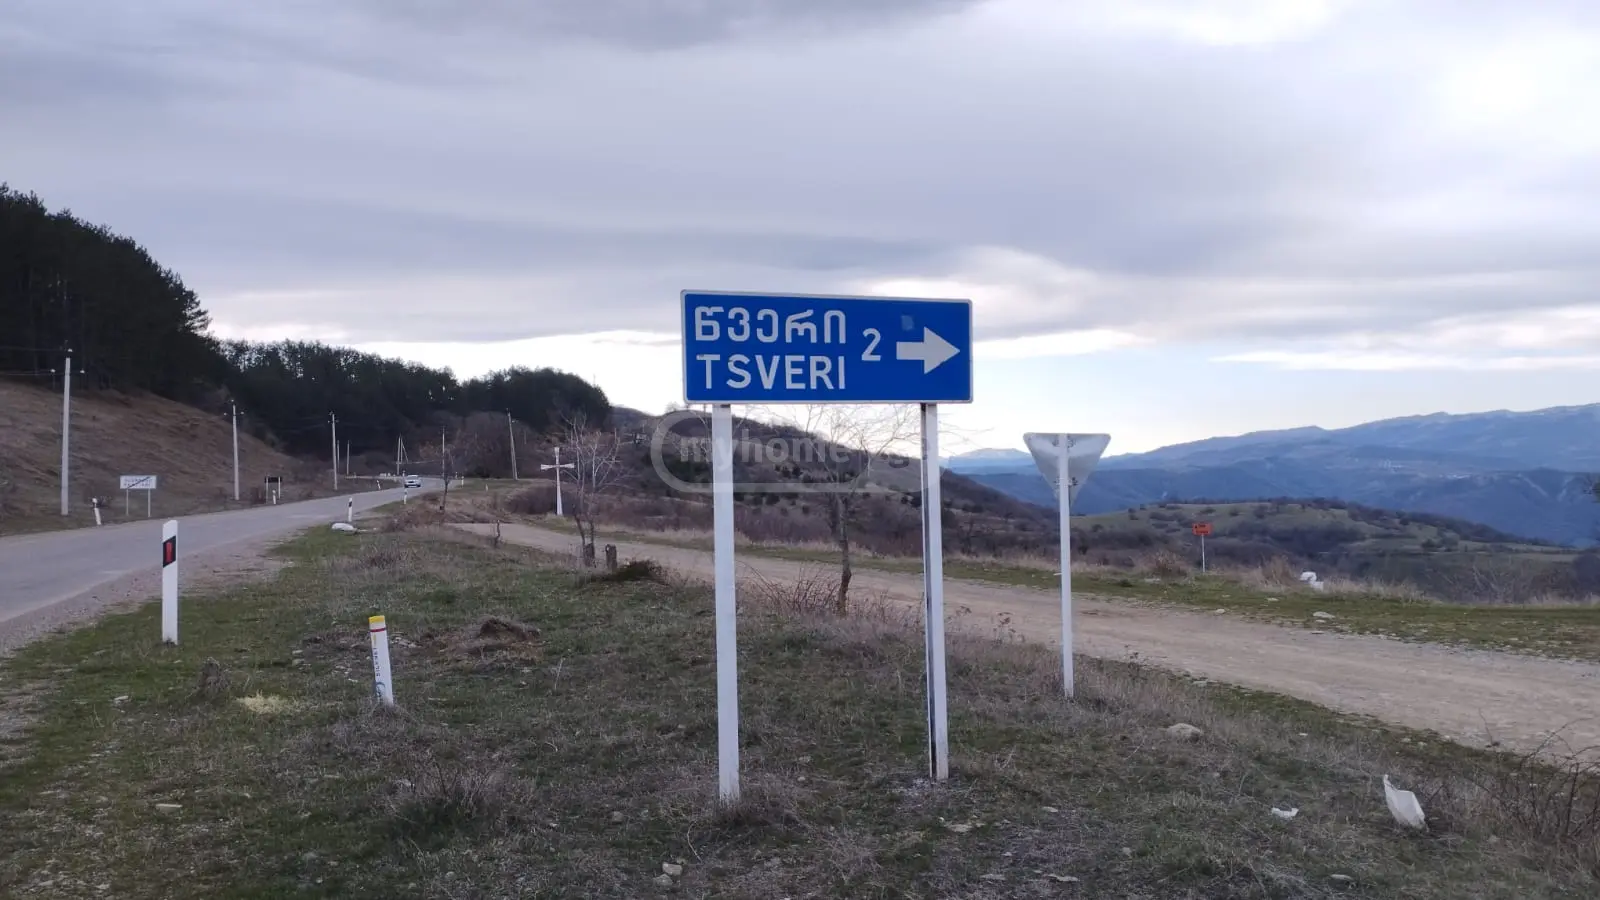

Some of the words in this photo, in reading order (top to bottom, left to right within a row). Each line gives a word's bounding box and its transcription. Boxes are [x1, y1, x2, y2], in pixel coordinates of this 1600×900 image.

[694, 306, 846, 344] წვერი
[861, 328, 882, 361] 2
[696, 354, 846, 390] TSVERI
